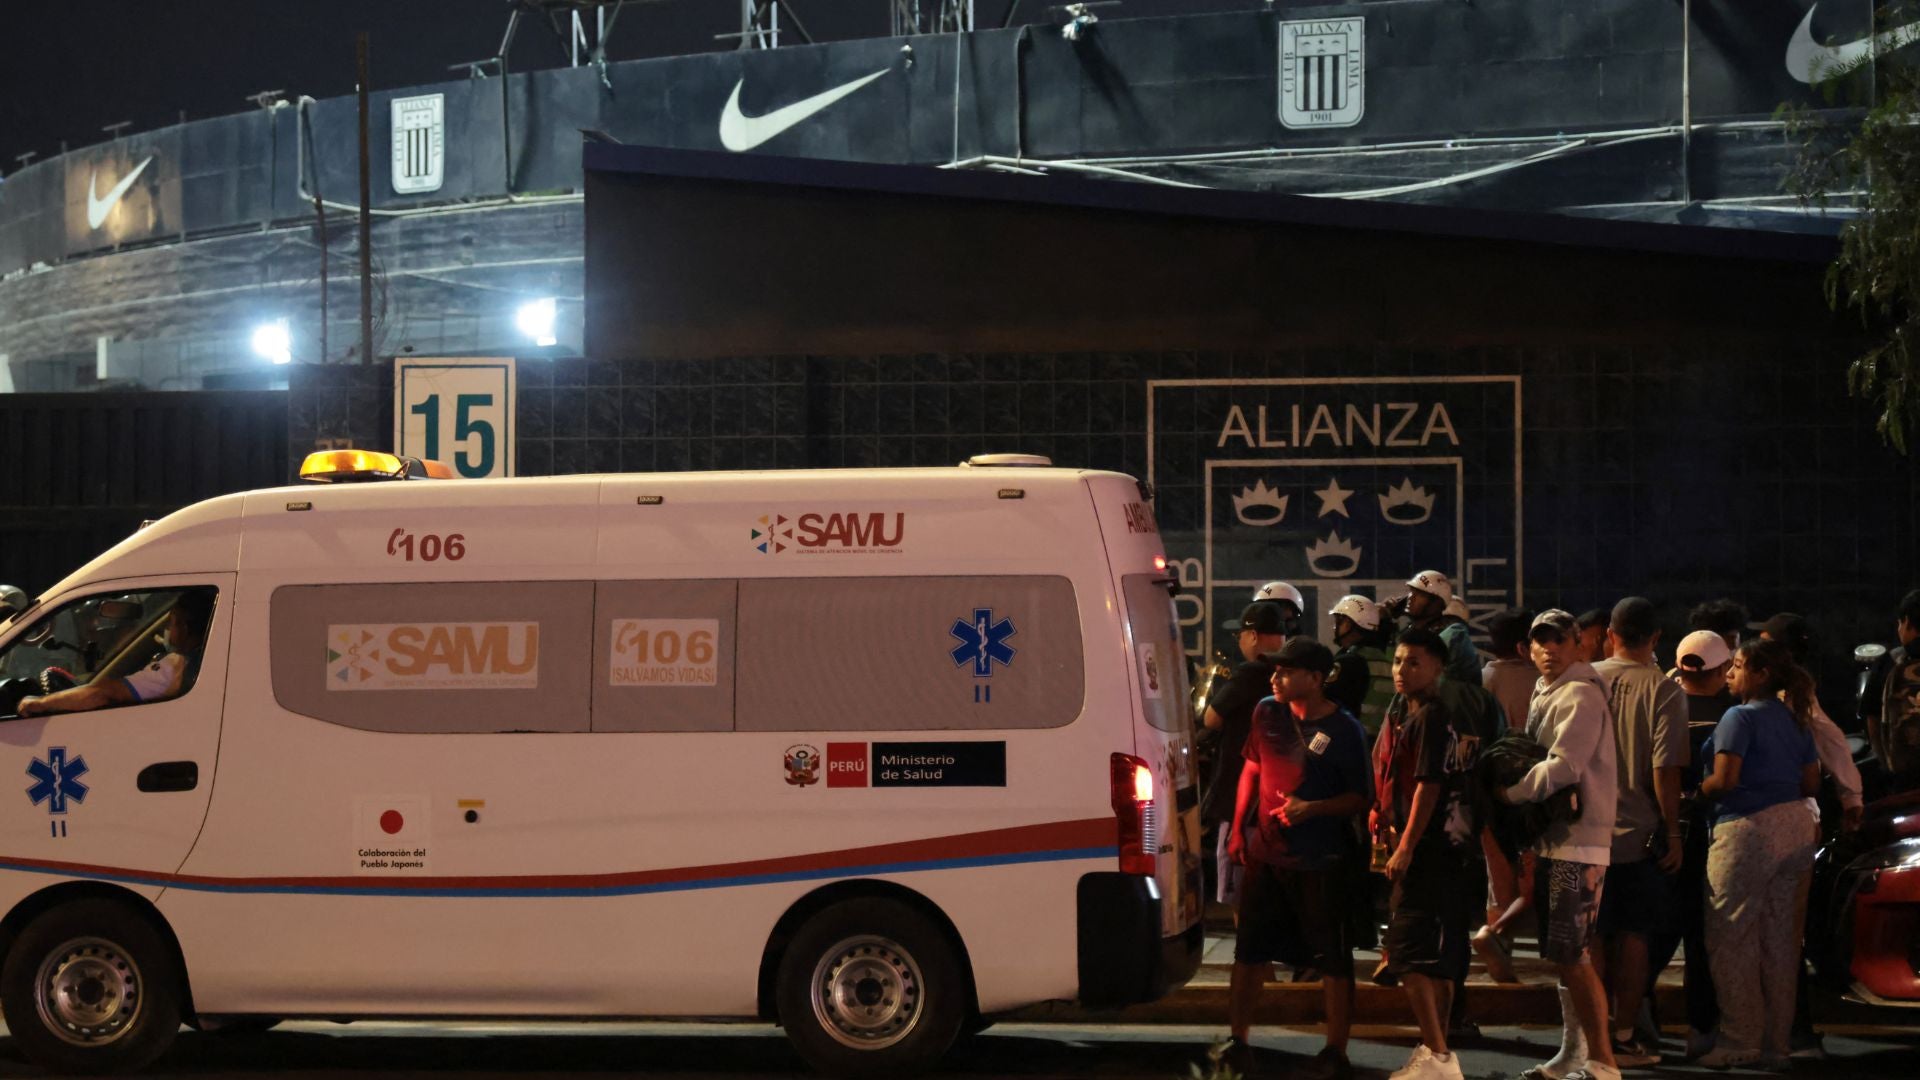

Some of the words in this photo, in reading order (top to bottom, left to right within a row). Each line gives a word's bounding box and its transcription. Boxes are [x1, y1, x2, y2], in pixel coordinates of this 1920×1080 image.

[1291, 22, 1353, 35] ALIANZA
[1283, 52, 1294, 93] CLUB
[1348, 49, 1360, 89] LIMA
[1310, 112, 1332, 122] 1901
[411, 394, 495, 479] 15
[1217, 402, 1460, 448] ALIANZA
[797, 512, 905, 547] SAMU
[398, 533, 466, 562] 106
[1167, 557, 1204, 658] LUB
[384, 626, 538, 676] SAMU
[628, 630, 713, 665] 106
[829, 758, 865, 772] PERÚ
[881, 755, 955, 766] Ministerio
[881, 769, 899, 780] de
[903, 769, 943, 780] Salud
[358, 849, 411, 857] Colaboración
[413, 849, 426, 857] del
[361, 860, 388, 868] Pueblo
[391, 860, 424, 869] Japonés
